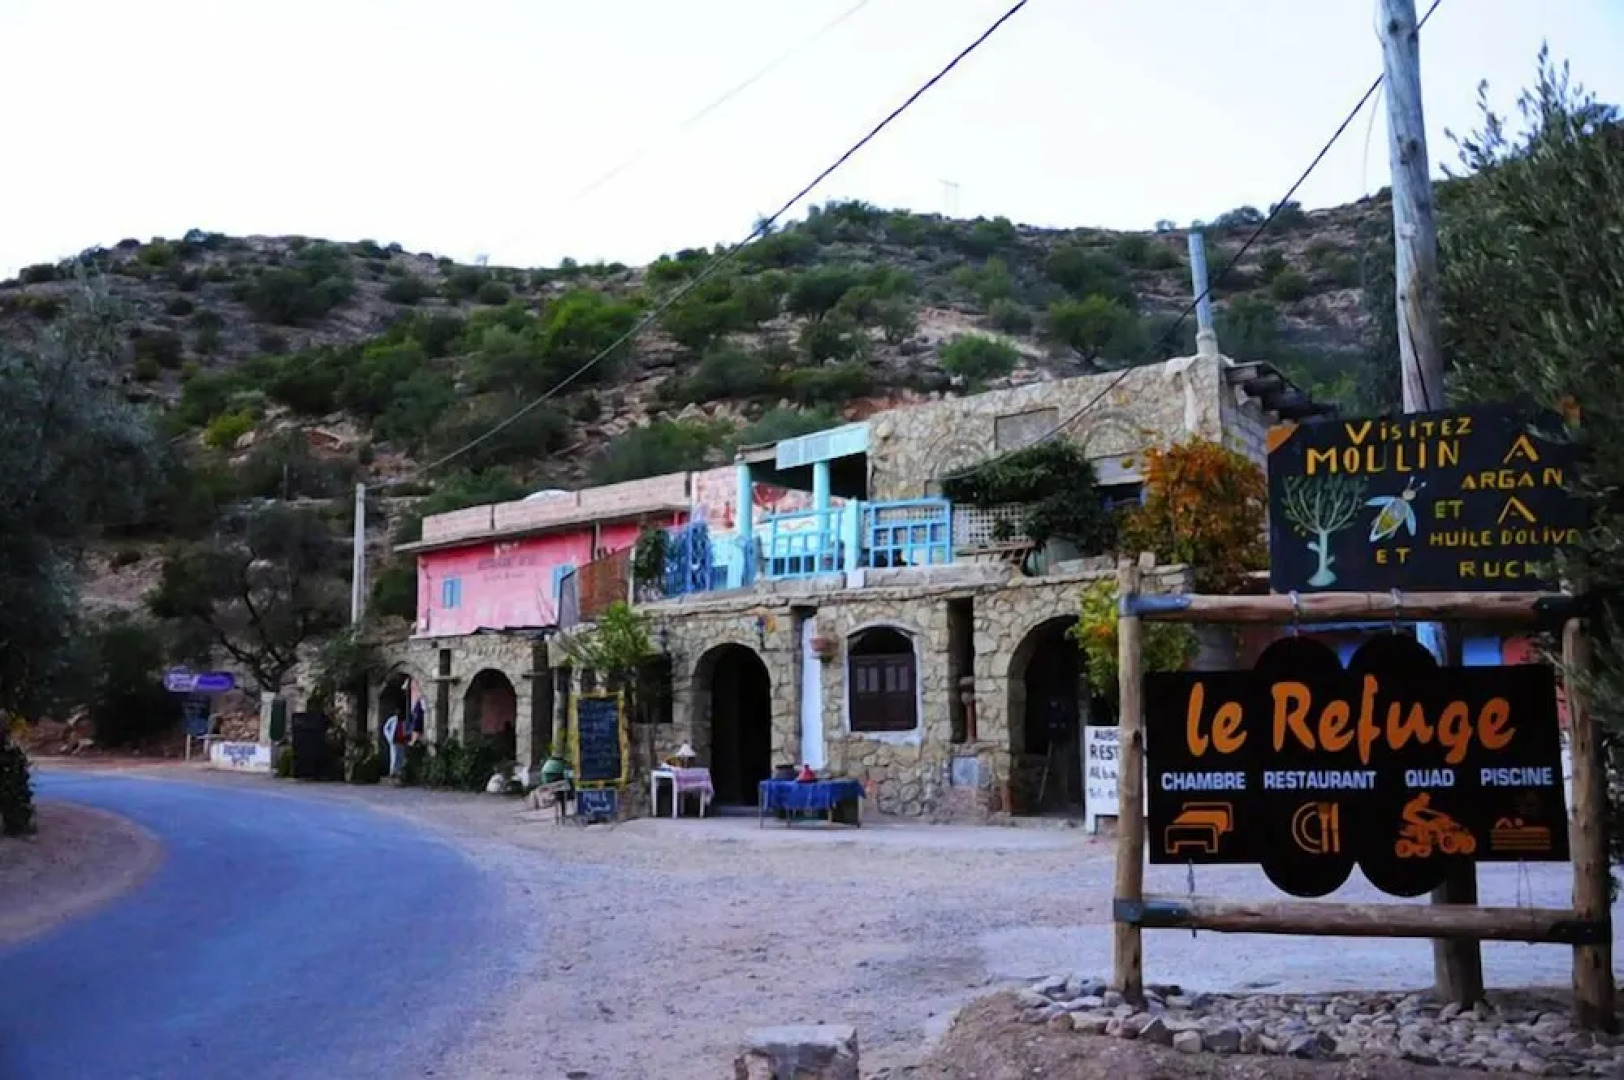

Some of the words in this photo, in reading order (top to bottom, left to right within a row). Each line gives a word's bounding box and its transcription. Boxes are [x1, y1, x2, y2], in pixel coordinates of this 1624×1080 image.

[1461, 467, 1563, 490] ARGAN
[1435, 500, 1464, 519] ET
[1376, 547, 1411, 565] ET
[1186, 681, 1249, 757] le
[1270, 673, 1517, 765] Refuge
[1161, 770, 1246, 791] CHAMBRE
[1264, 769, 1377, 790] RESTAURANT
[1405, 768, 1455, 788] QUAD
[1480, 766, 1554, 787] PISCINE
